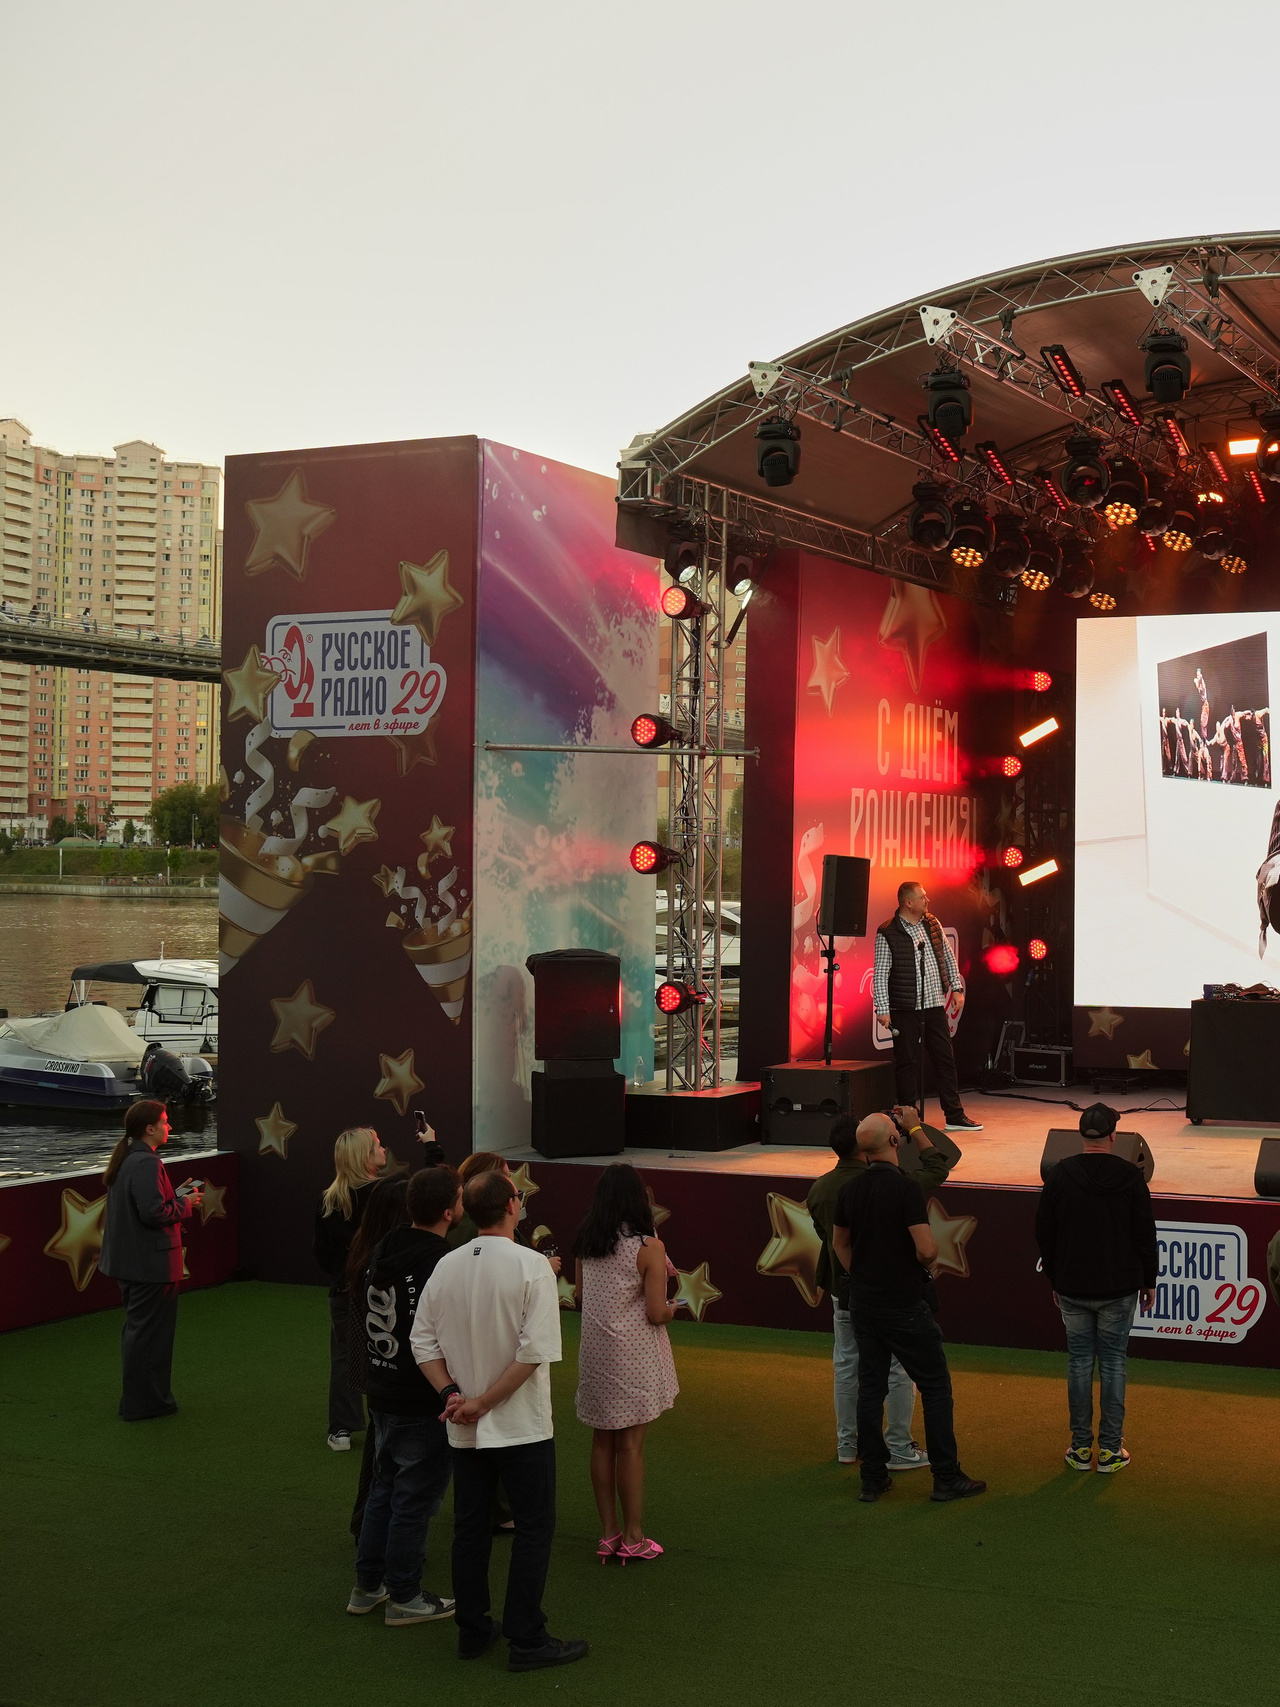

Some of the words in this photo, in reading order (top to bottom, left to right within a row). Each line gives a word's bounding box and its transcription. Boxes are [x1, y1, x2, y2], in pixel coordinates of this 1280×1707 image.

[321, 629, 411, 672] РУССКОЕ
[320, 676, 387, 717] РАДИО
[391, 670, 441, 716] 29
[348, 722, 371, 731] лет
[373, 718, 381, 731] в
[383, 718, 421, 734] эфире
[876, 698, 891, 776] С
[900, 699, 960, 785] ДНЁМ
[850, 787, 977, 869] РОЖДЕНИЯ!
[44, 1060, 80, 1073] CROSSWIND
[1155, 1240, 1226, 1281] ССКОЕ
[1205, 1283, 1260, 1326] 29
[1156, 1325, 1183, 1335] лет
[1185, 1324, 1194, 1335] в
[1195, 1327, 1238, 1342] эфире
